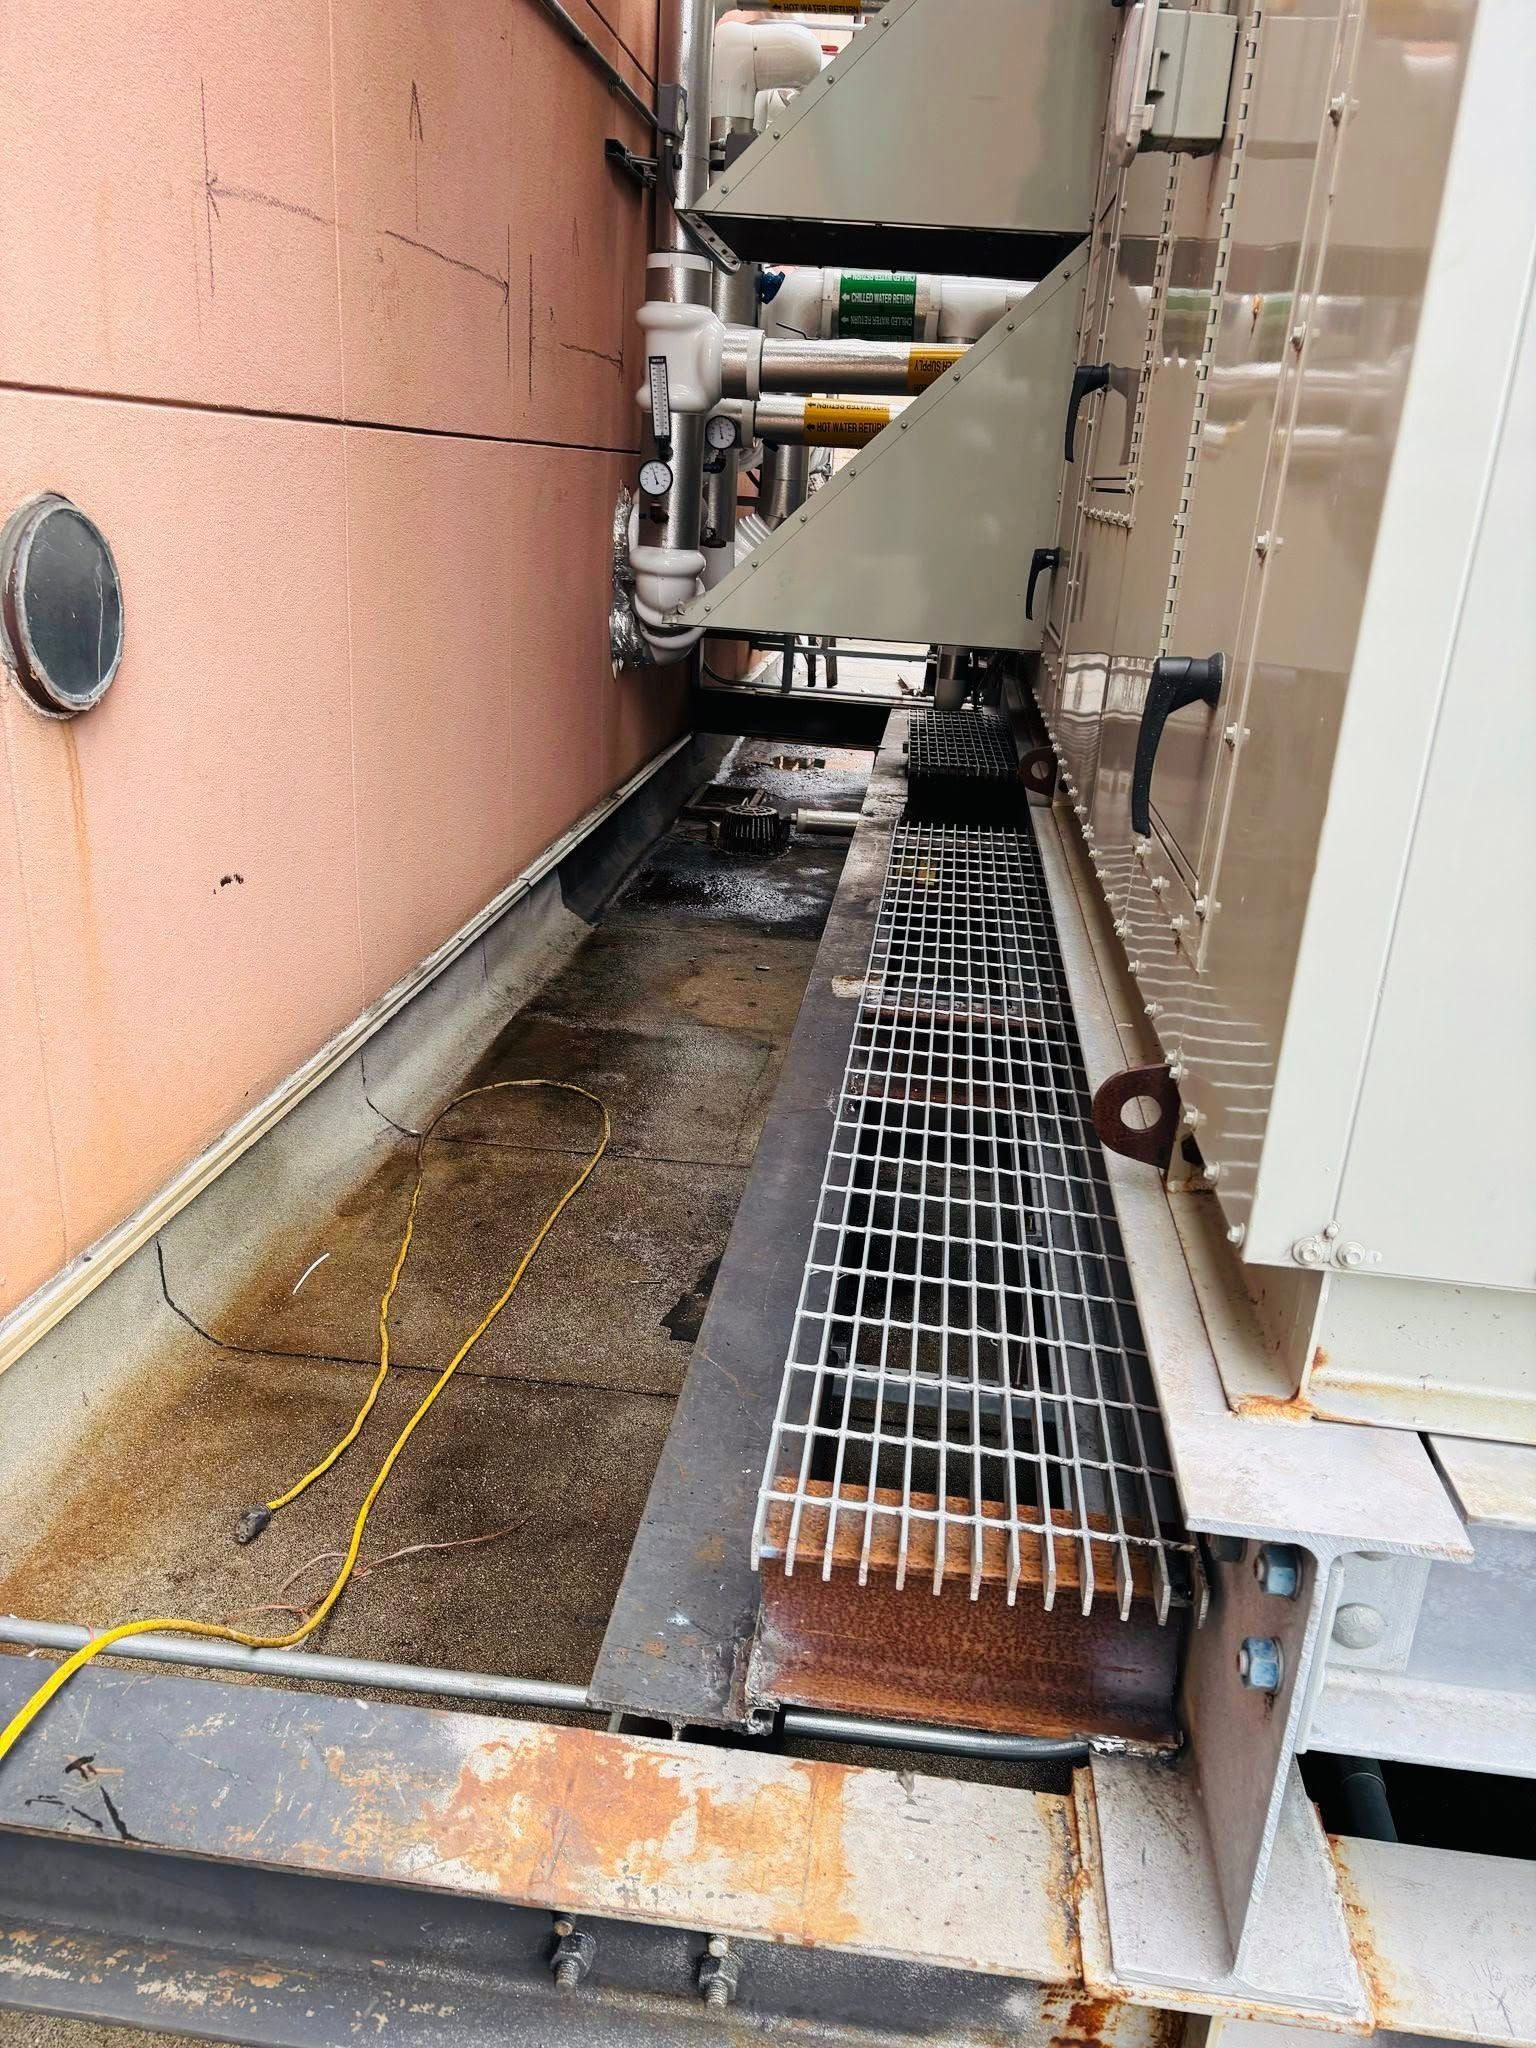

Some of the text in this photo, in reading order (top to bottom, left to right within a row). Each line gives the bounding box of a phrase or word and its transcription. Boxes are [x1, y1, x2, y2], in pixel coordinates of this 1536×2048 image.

[784, 4, 859, 14] HOT WATER RETURN
[851, 292, 914, 304] CHILLED WATER RETURN
[891, 316, 913, 326] CHILLED
[914, 360, 941, 374] SUPPLY
[816, 422, 831, 433] HOT
[832, 422, 857, 433] WATER
